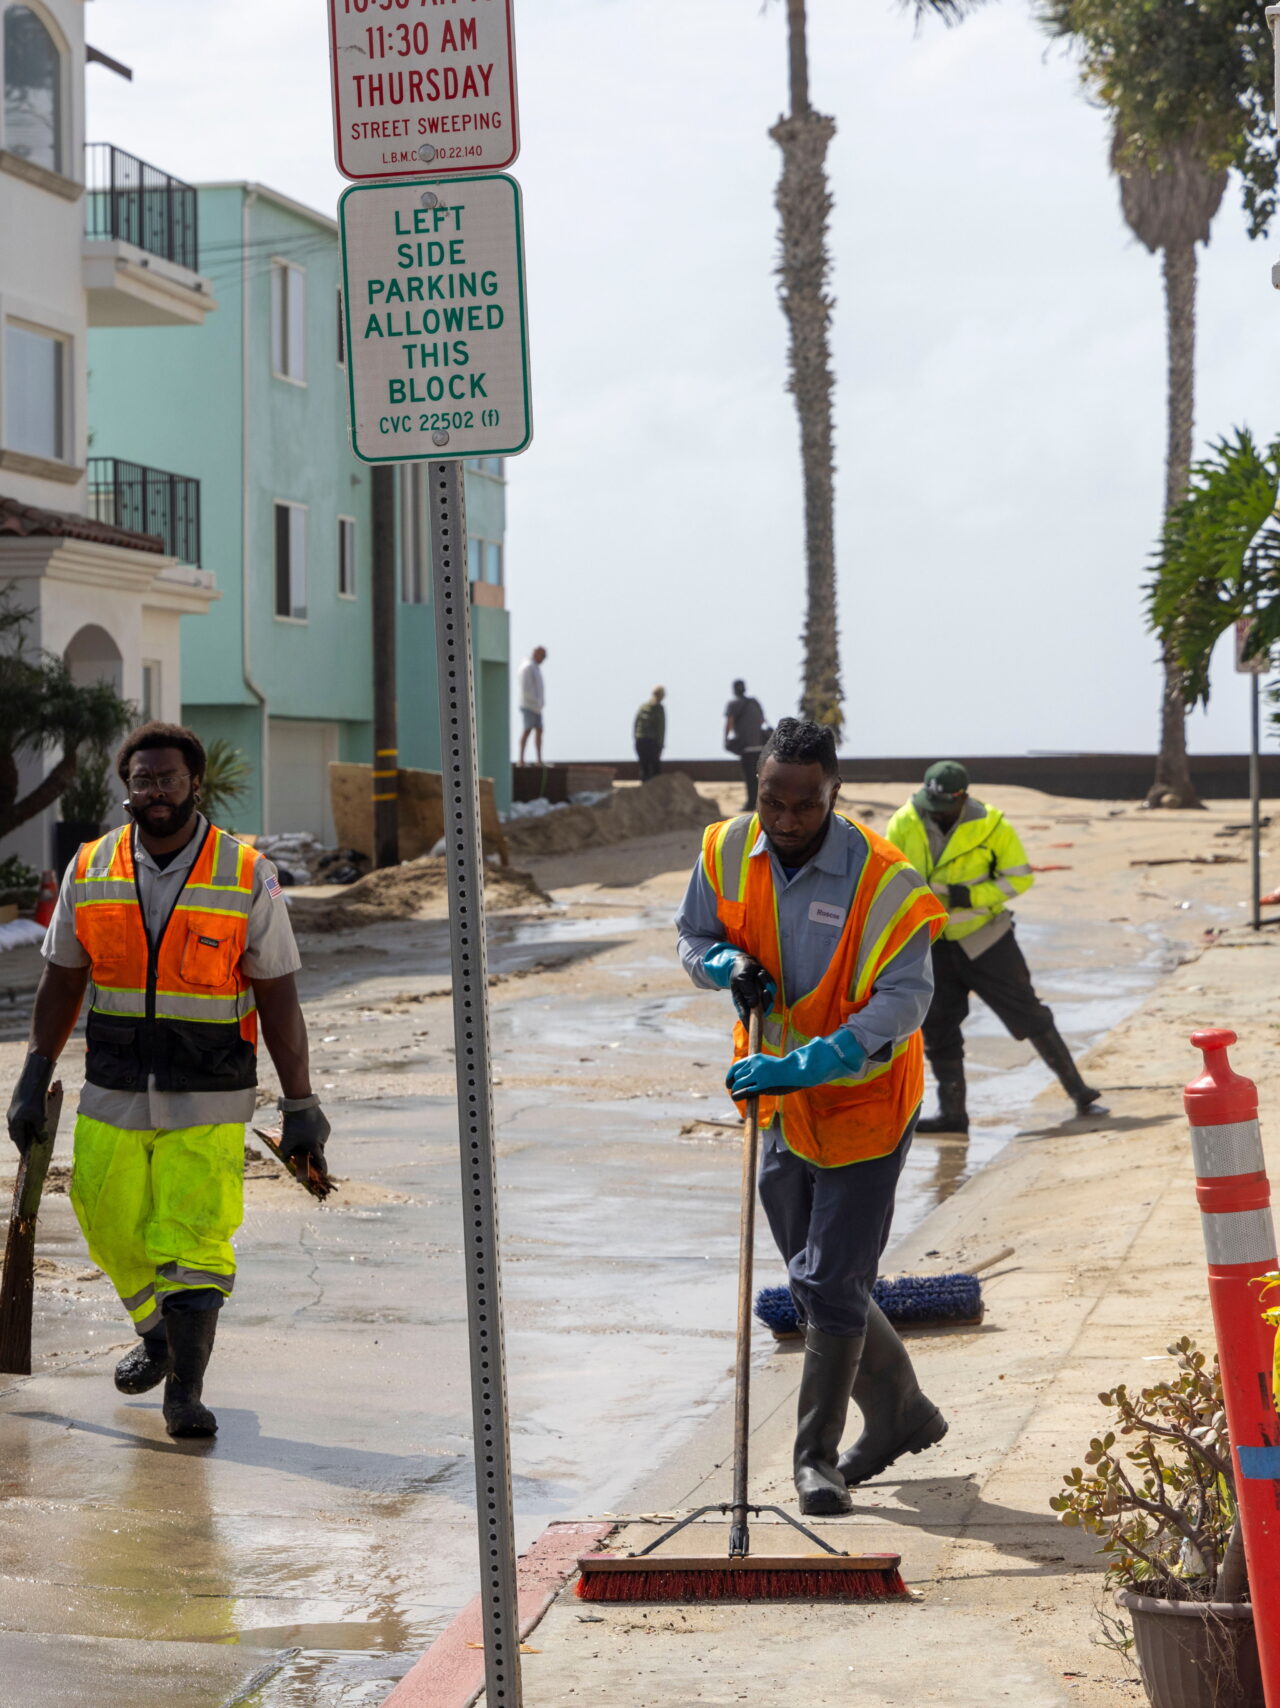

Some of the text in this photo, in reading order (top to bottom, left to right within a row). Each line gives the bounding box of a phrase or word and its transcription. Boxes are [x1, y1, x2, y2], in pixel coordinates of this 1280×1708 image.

[366, 17, 478, 59] 11:30 AM
[352, 63, 494, 108] THURSDAY
[351, 111, 502, 140] STREET SWEEPING
[435, 145, 483, 159] 10.22.140
[394, 205, 466, 236] LEFT
[397, 239, 466, 269] SIDE
[367, 270, 498, 305] PARKING
[364, 304, 505, 339] ALLOWED
[402, 340, 470, 370] THIS
[388, 372, 488, 405] BLOCK
[379, 408, 500, 434] CVC 22502 (f)
